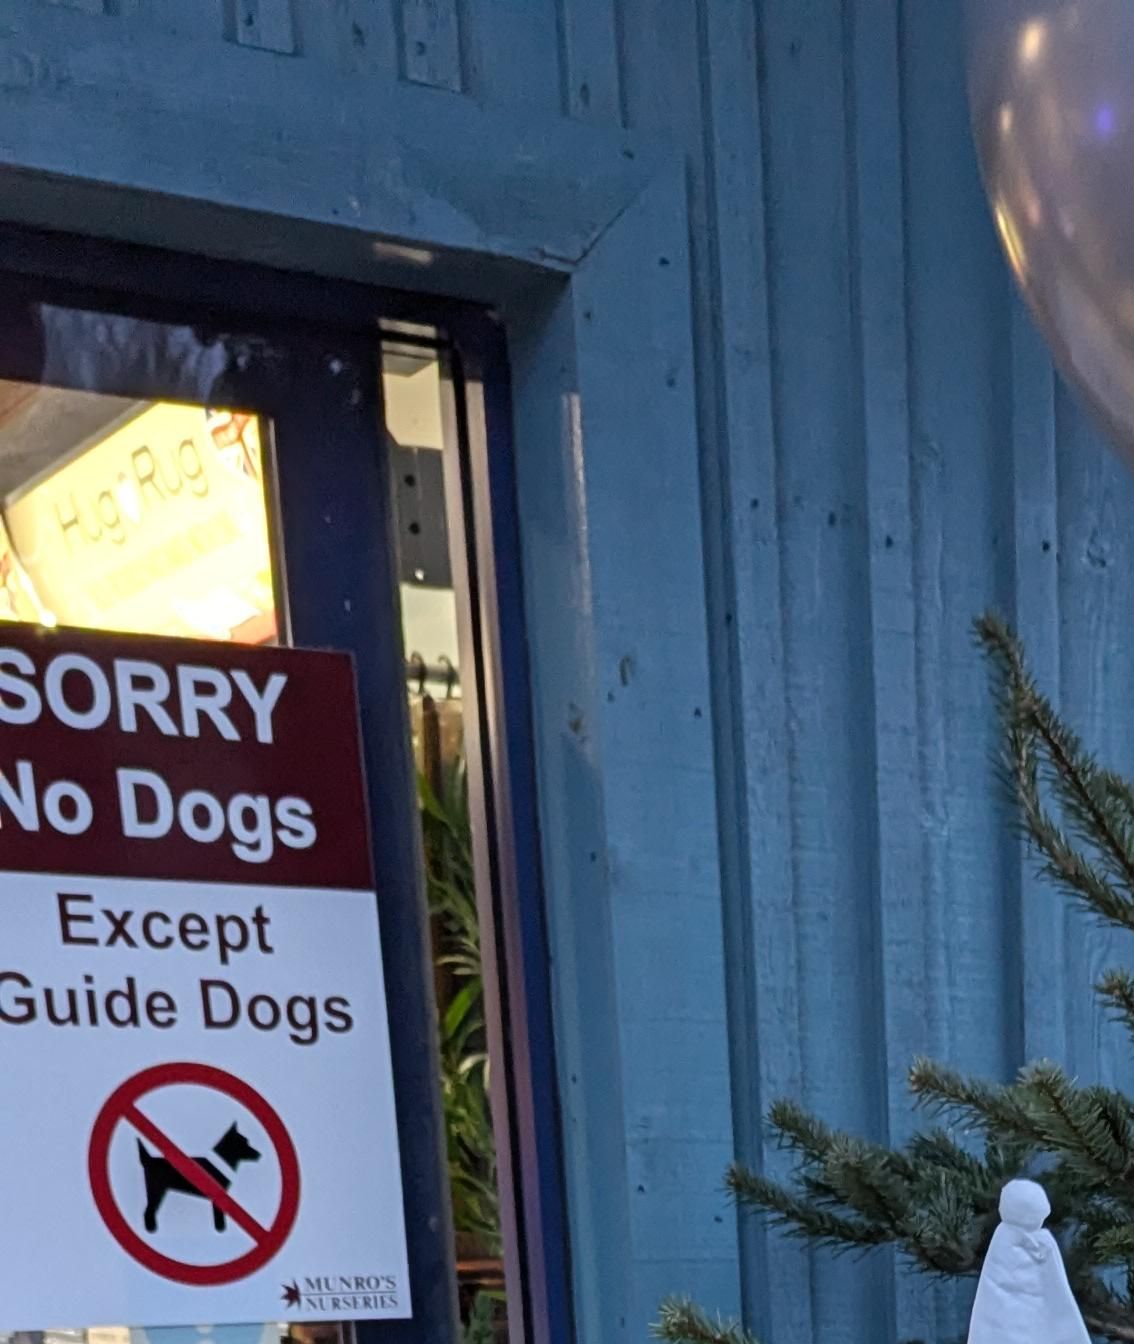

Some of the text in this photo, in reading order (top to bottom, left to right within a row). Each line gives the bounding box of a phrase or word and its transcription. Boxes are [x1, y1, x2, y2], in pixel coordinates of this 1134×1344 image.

[131, 437, 209, 508] Rug
[0, 647, 288, 744] SORRY
[0, 760, 317, 863] No Dogs
[57, 892, 274, 966] Except
[0, 970, 353, 1046] Guide Dogs
[304, 1275, 397, 1292] MUNRO'S
[304, 1295, 398, 1312] NURSERIES
